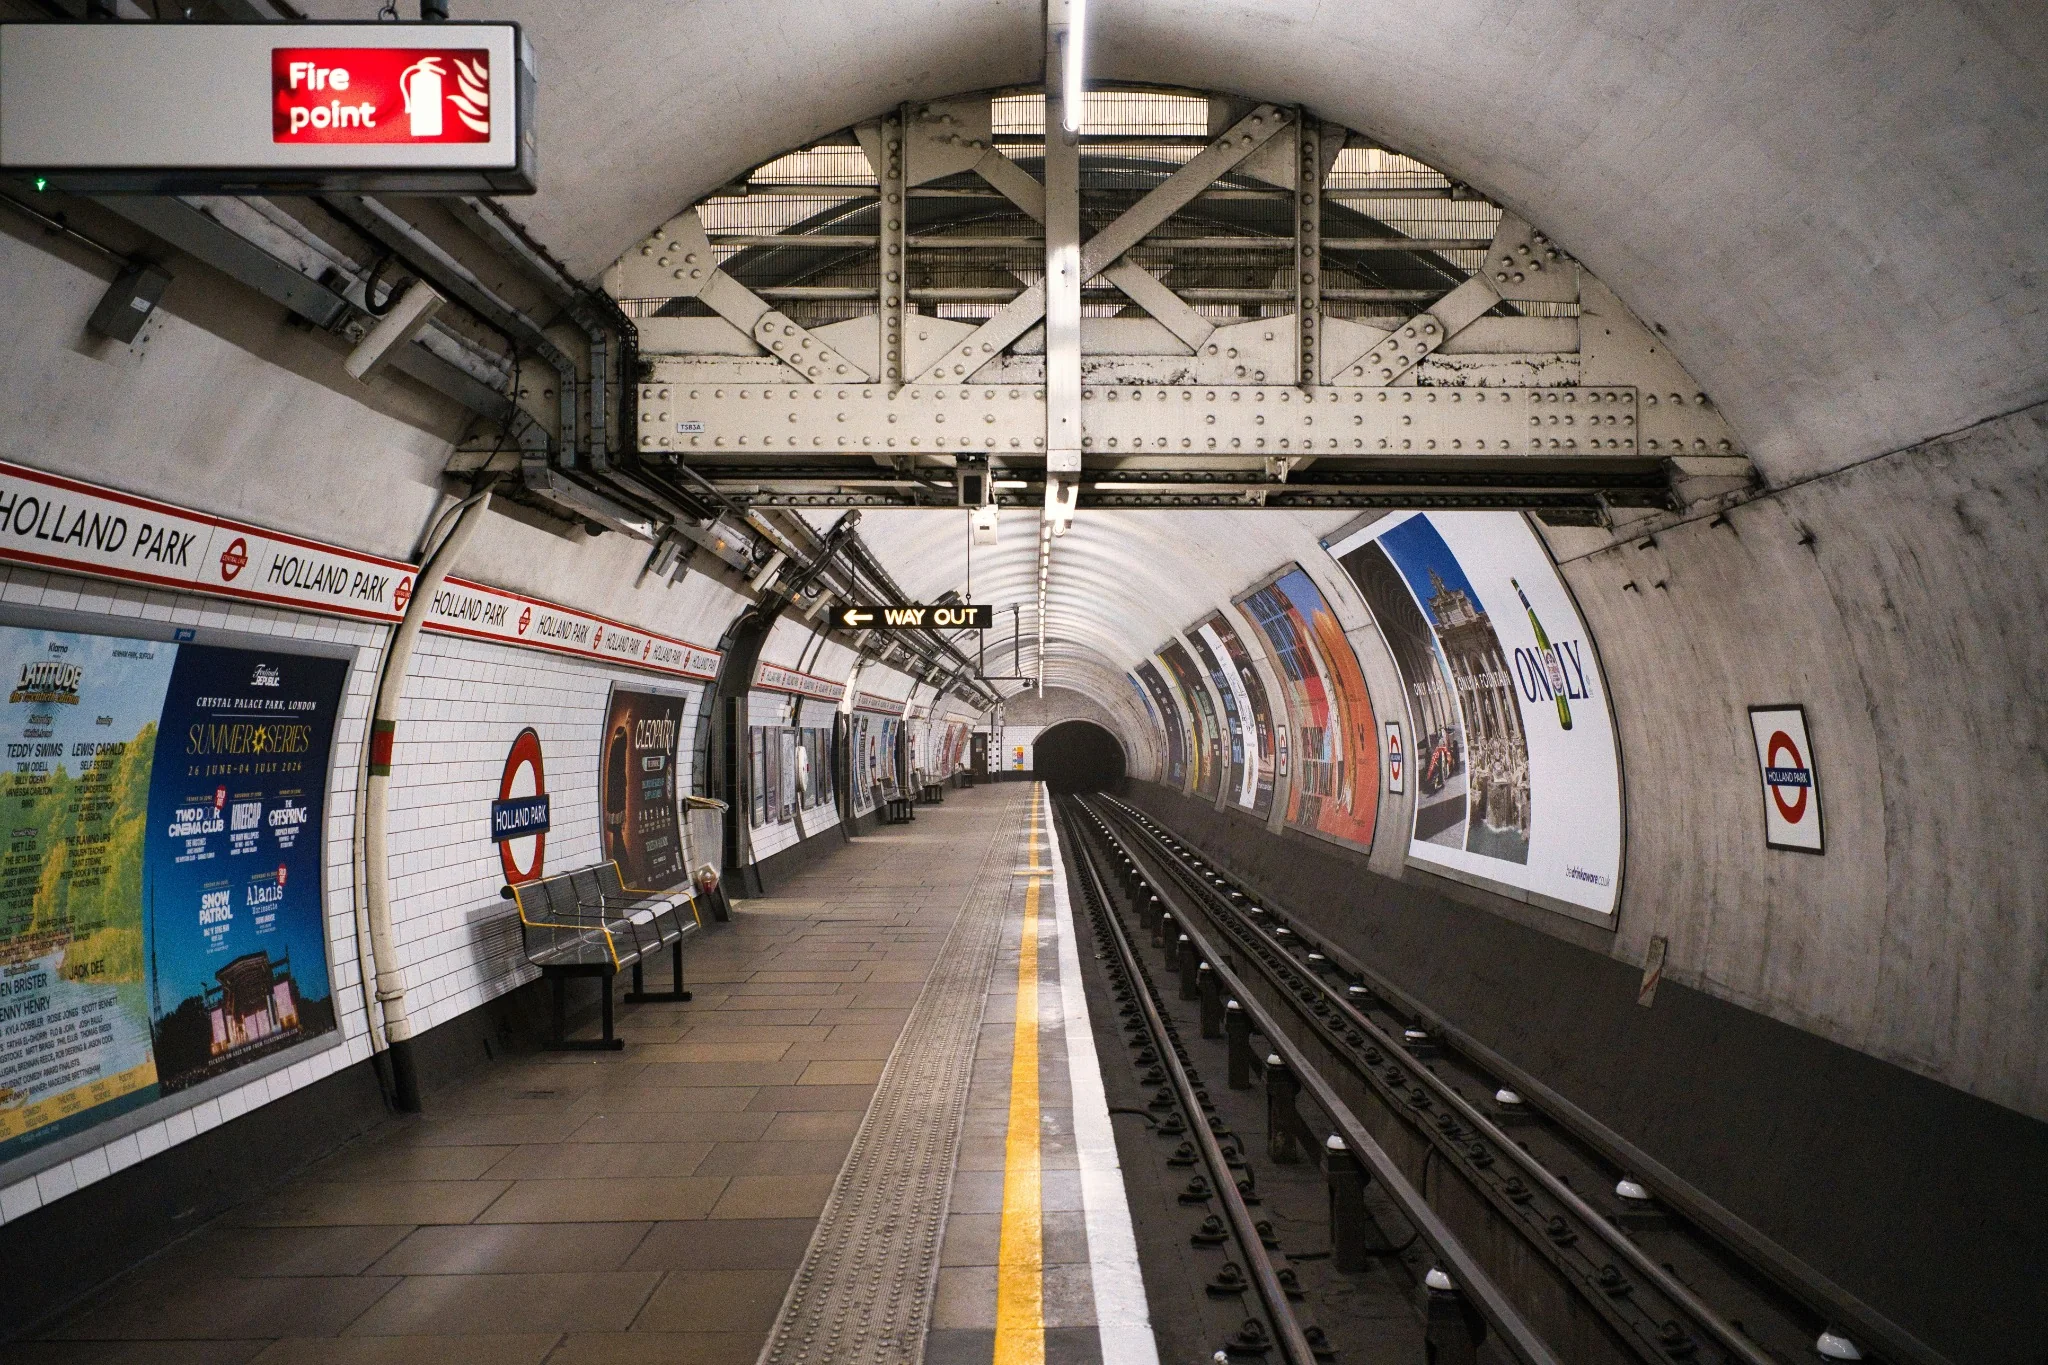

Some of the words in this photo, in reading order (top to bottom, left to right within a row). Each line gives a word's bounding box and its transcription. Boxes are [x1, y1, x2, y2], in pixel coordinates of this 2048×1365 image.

[290, 62, 350, 91] Fire
[290, 99, 376, 135] point
[0, 490, 127, 553] HOLLAND
[132, 523, 196, 567] PARK
[267, 554, 348, 595] HOLLAND
[349, 571, 389, 603] PARK
[430, 590, 482, 621] HOLLAND
[482, 602, 509, 627] PARK
[884, 608, 926, 625] WAY
[934, 608, 978, 625] OUT
[537, 615, 572, 640] HOLLAND
[571, 623, 590, 644] PARK
[48, 641, 68, 653] Klarna
[605, 633, 630, 653] HOLLAND
[628, 638, 641, 655] PARK
[17, 661, 83, 691] LATITUDE
[254, 676, 280, 687] REPUBLIC
[1457, 676, 1474, 691] ONLY
[1480, 670, 1513, 689] FOUNTAIN
[196, 697, 232, 708] CRYSTAL
[233, 698, 263, 709] PALACE
[264, 700, 286, 711] PARK,
[288, 701, 317, 711] LONDON
[187, 723, 254, 755] SUMMER
[264, 724, 312, 754] SERIES
[636, 713, 675, 754] CLEOPATRA
[7, 743, 34, 758] TEDDY
[35, 743, 63, 757] SWIMS
[72, 743, 95, 757] LEWIS
[95, 742, 126, 756] CAPALDI
[17, 762, 30, 772] TOM
[31, 761, 49, 771] ODELL
[80, 761, 93, 770] SELF
[93, 760, 114, 769] ESTEEM
[188, 765, 200, 777] 26
[254, 761, 277, 774] JULY
[281, 761, 302, 772] 2026
[15, 776, 28, 785] BILLY
[29, 775, 47, 784] OCEAN
[1768, 771, 1793, 783] HOLLAND
[1793, 772, 1808, 783] PARK
[6, 788, 30, 797] VANESSA
[30, 787, 53, 796] CARLTON
[285, 799, 293, 808] THE
[175, 809, 196, 822] TWO
[196, 806, 221, 821] DOOR
[231, 802, 262, 831] KNEECAP
[268, 806, 307, 827] OFFSPRING
[495, 807, 530, 832] HOLLAND
[531, 804, 547, 824] PARK
[168, 822, 203, 838] CINEMA
[202, 819, 225, 834] CLUB
[12, 842, 24, 852] WET
[25, 841, 37, 851] LEG
[65, 836, 77, 846] THE
[77, 834, 99, 845] FLAMING
[100, 833, 111, 843] LIPS
[87, 846, 106, 856] TEACHER
[202, 890, 230, 910] SNOW
[246, 882, 283, 906] Alanis
[199, 905, 234, 926] PATROL
[69, 961, 89, 980] JACK
[91, 960, 105, 975] DEE
[14, 973, 48, 994] BRISTER
[0, 1002, 21, 1019] ENNY
[24, 996, 51, 1016] HENRY
[5, 1022, 20, 1036] KYLA
[20, 1017, 44, 1032] COBBLER
[47, 1012, 62, 1025] ROSIE
[62, 1007, 79, 1021] JONES
[81, 1002, 98, 1015] SCOTT
[98, 997, 118, 1010] BENNETT
